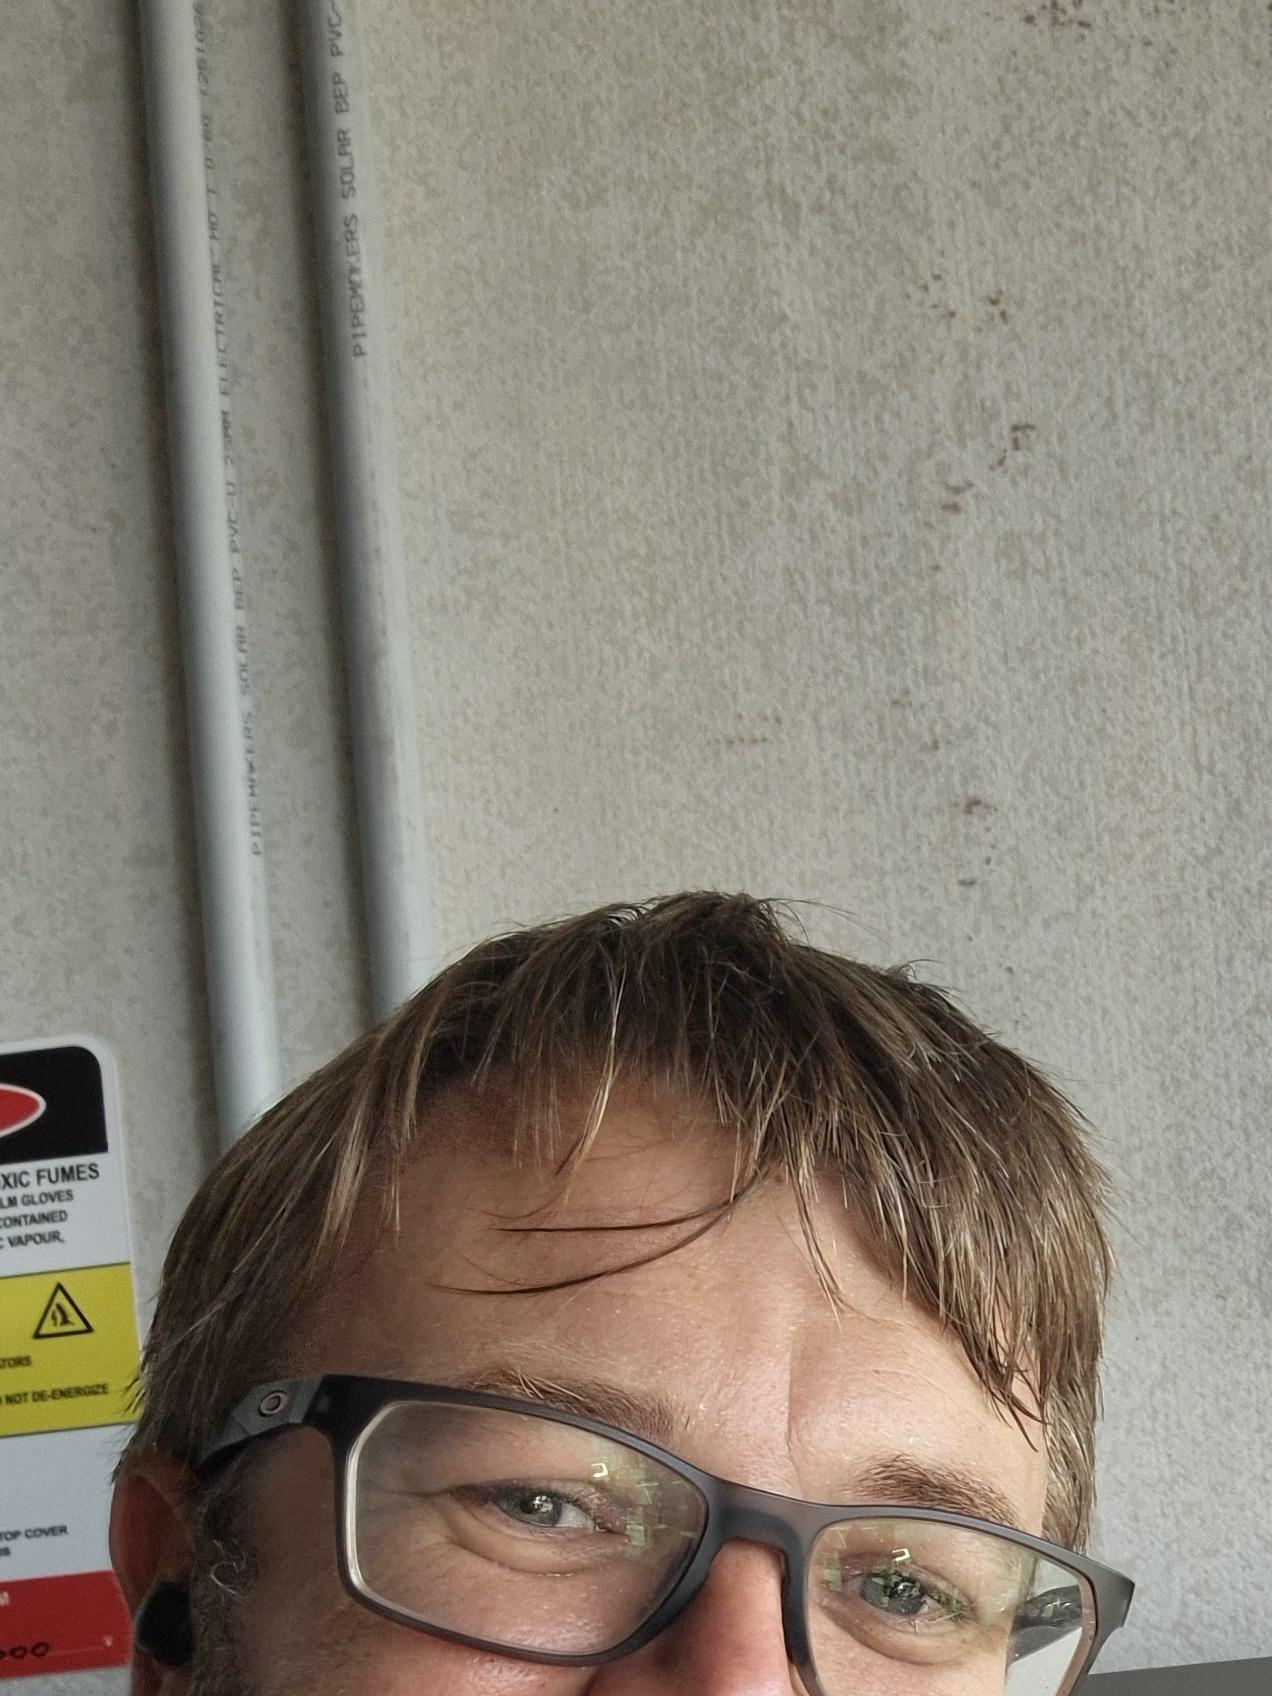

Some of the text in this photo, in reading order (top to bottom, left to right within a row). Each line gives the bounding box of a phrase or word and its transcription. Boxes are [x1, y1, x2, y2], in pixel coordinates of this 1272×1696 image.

[331, 71, 350, 114] BEP
[336, 129, 357, 200] SOLAR
[343, 213, 367, 358] PIPEMAKERS
[235, 625, 250, 696] SOLAR
[0, 1163, 100, 1190] XIC FUMES
[21, 1189, 74, 1206] GLOVES
[25, 1525, 69, 1539] COVER
